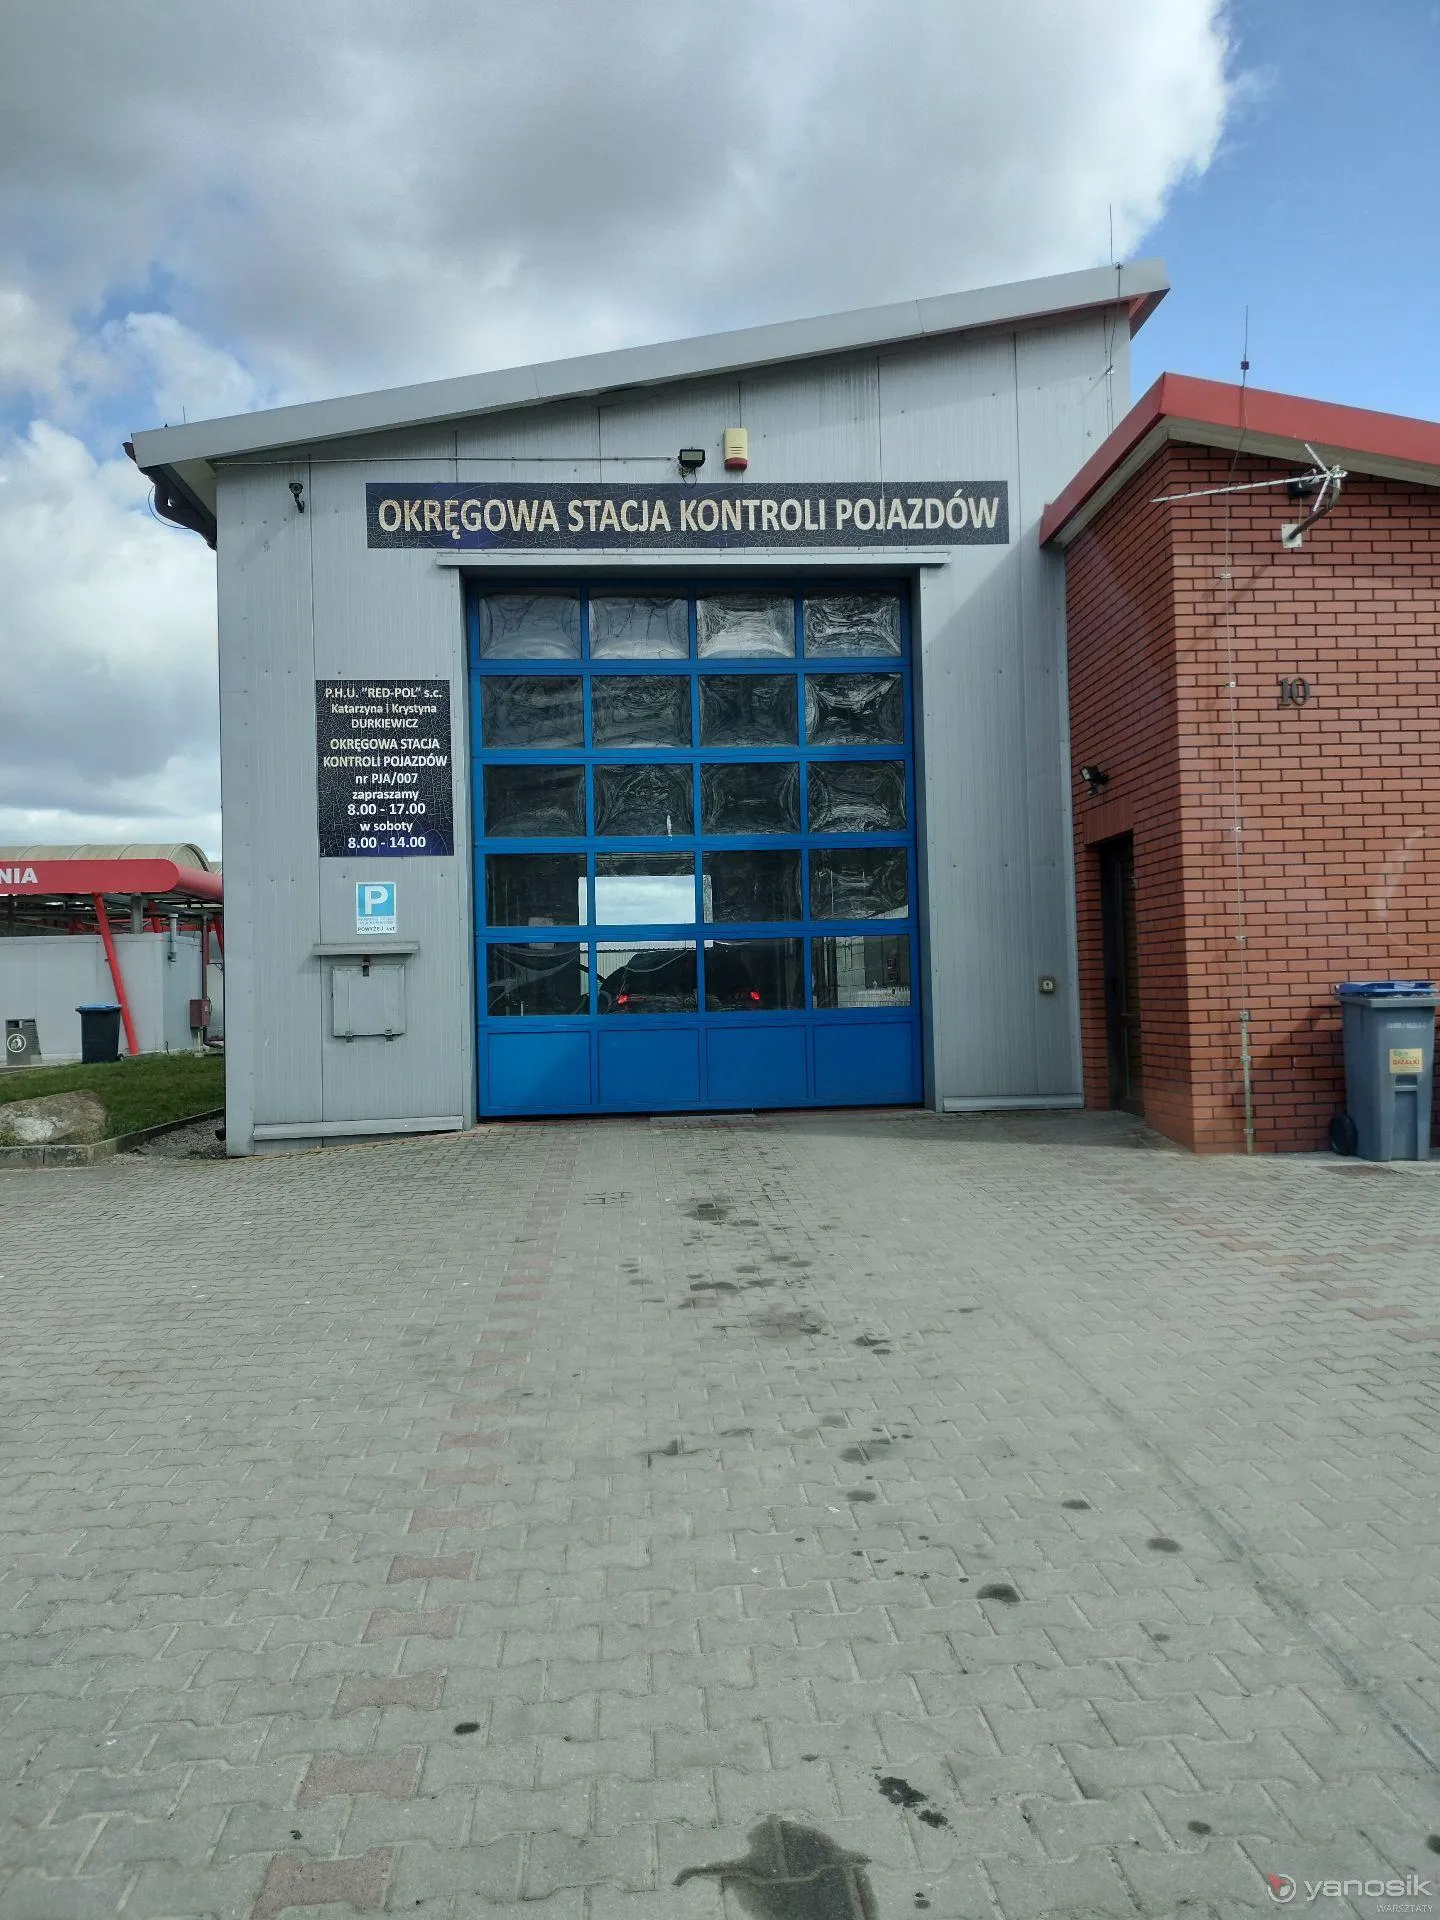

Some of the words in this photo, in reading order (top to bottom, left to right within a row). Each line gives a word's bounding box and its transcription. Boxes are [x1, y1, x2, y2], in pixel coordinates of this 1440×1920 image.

[378, 499, 559, 540] OKRĘGOWA
[567, 498, 670, 532] STACJA
[679, 498, 826, 531] KONTROLI
[836, 489, 1000, 530] POJAZDÓW
[325, 688, 358, 698] P.H.U.
[424, 689, 442, 697] s.c.
[1278, 677, 1310, 706] 10
[331, 704, 383, 714] Katarzyna
[386, 704, 388, 712] i
[392, 704, 437, 715] Krystyna
[352, 719, 418, 728] DURKIEWICZ
[330, 739, 398, 752] OKRĘGOWA
[400, 739, 440, 749] STACJA
[323, 757, 380, 767] KONTROLI
[383, 753, 447, 766] POJAZDÓW
[356, 775, 367, 783] nr
[372, 773, 418, 785] PJA/007
[352, 791, 419, 801] zapraszamy
[348, 804, 376, 815] 8.00
[390, 803, 425, 814] 17.00
[360, 823, 370, 831] w
[374, 821, 413, 832] soboty
[348, 837, 377, 848] 8.00
[390, 837, 426, 848] 14.00
[365, 886, 388, 914] P
